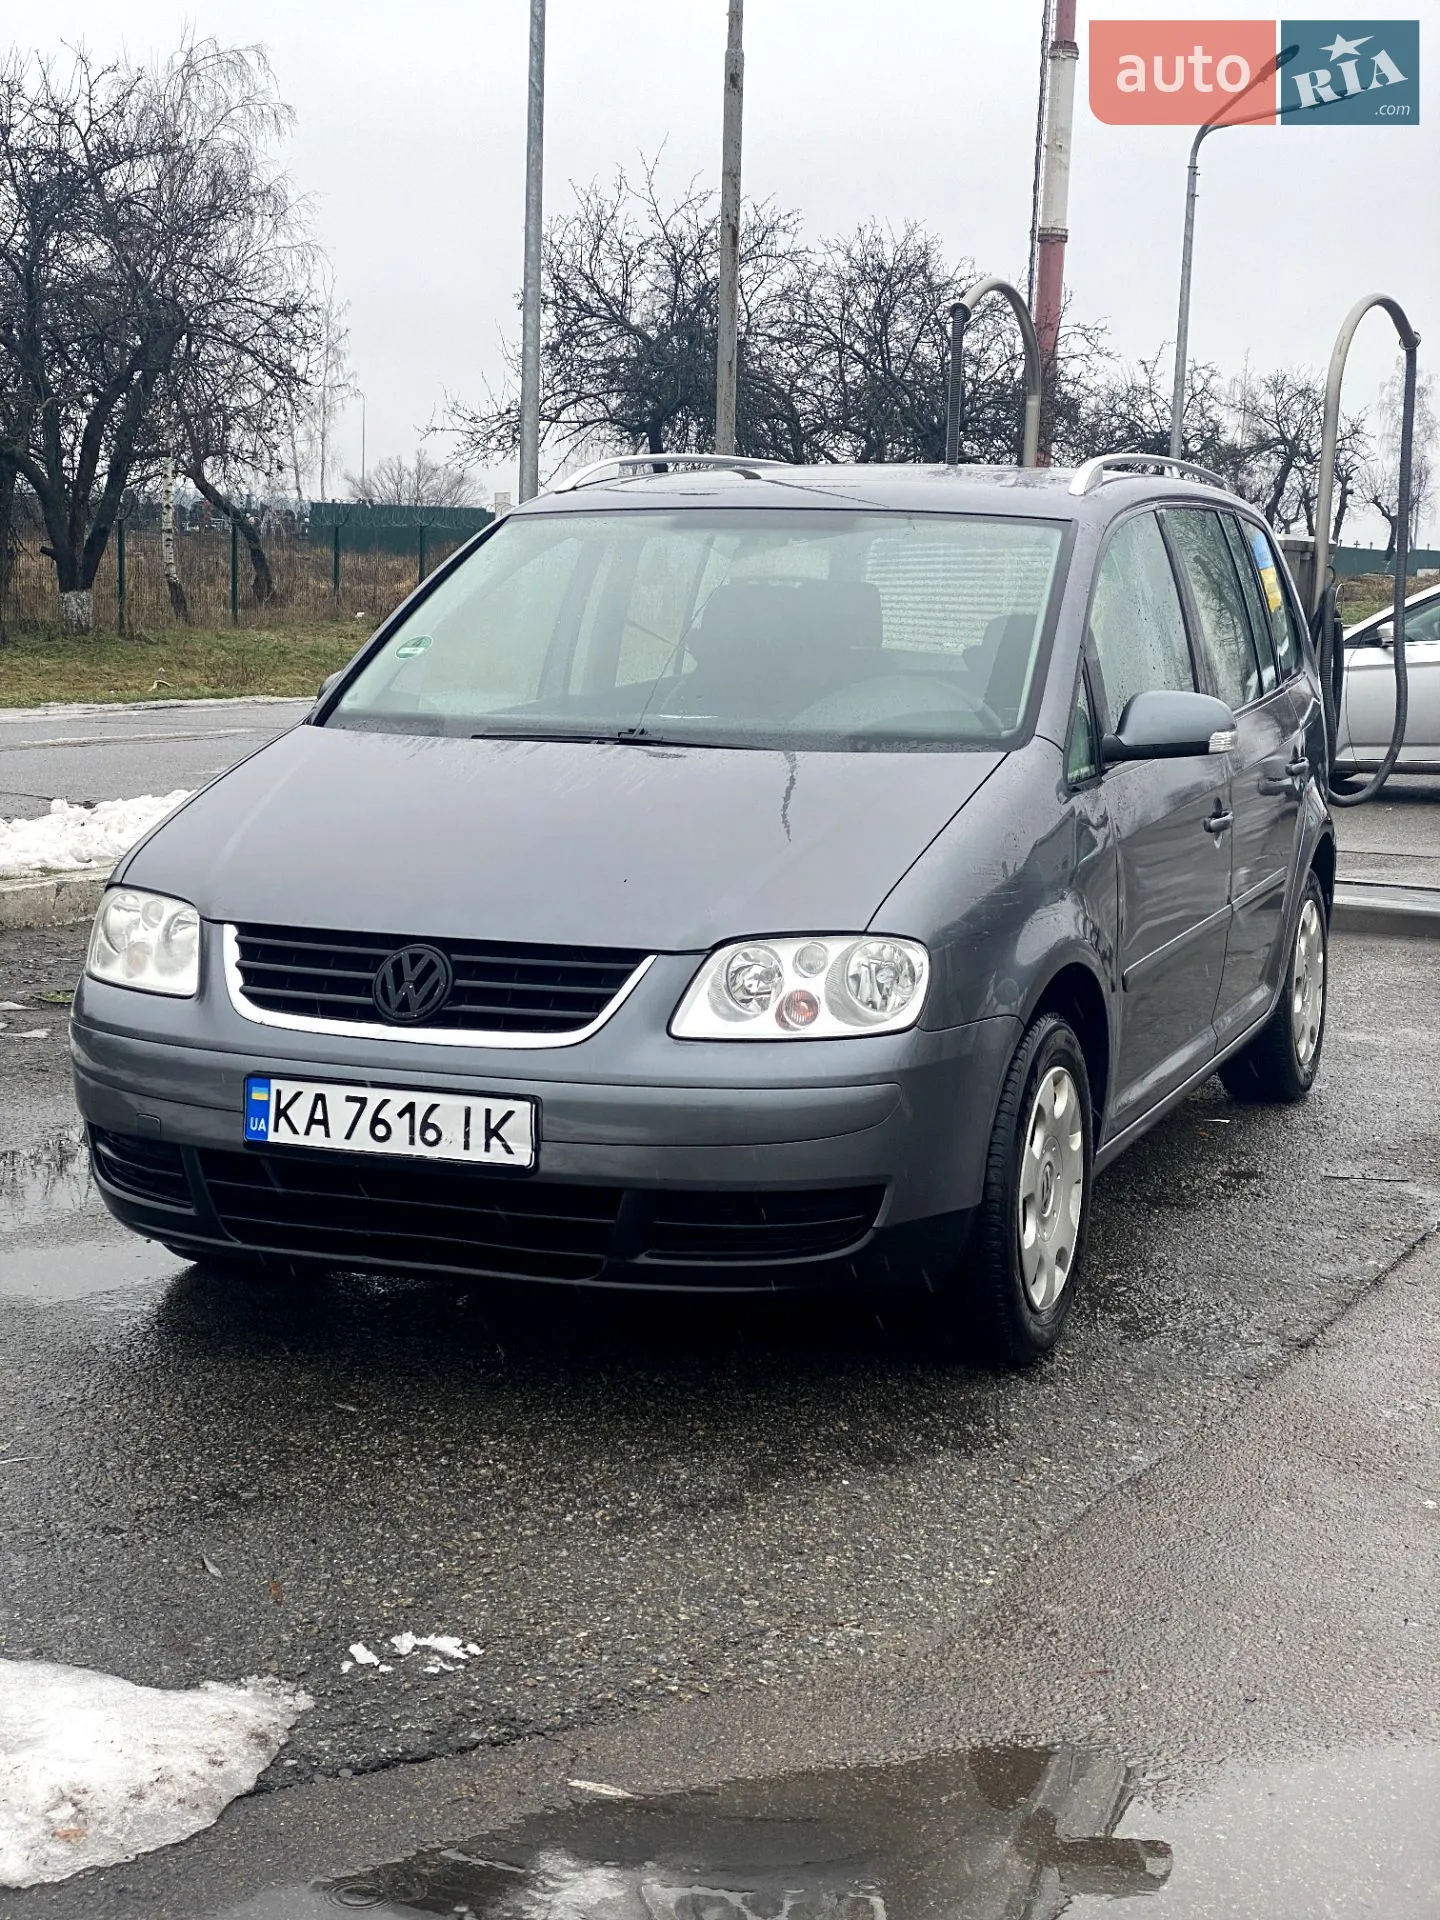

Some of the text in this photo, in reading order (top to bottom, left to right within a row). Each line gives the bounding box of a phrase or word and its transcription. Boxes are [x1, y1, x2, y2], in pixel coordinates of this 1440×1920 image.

[249, 1116, 267, 1133] UA
[272, 1088, 516, 1155] KA 7616 IK
